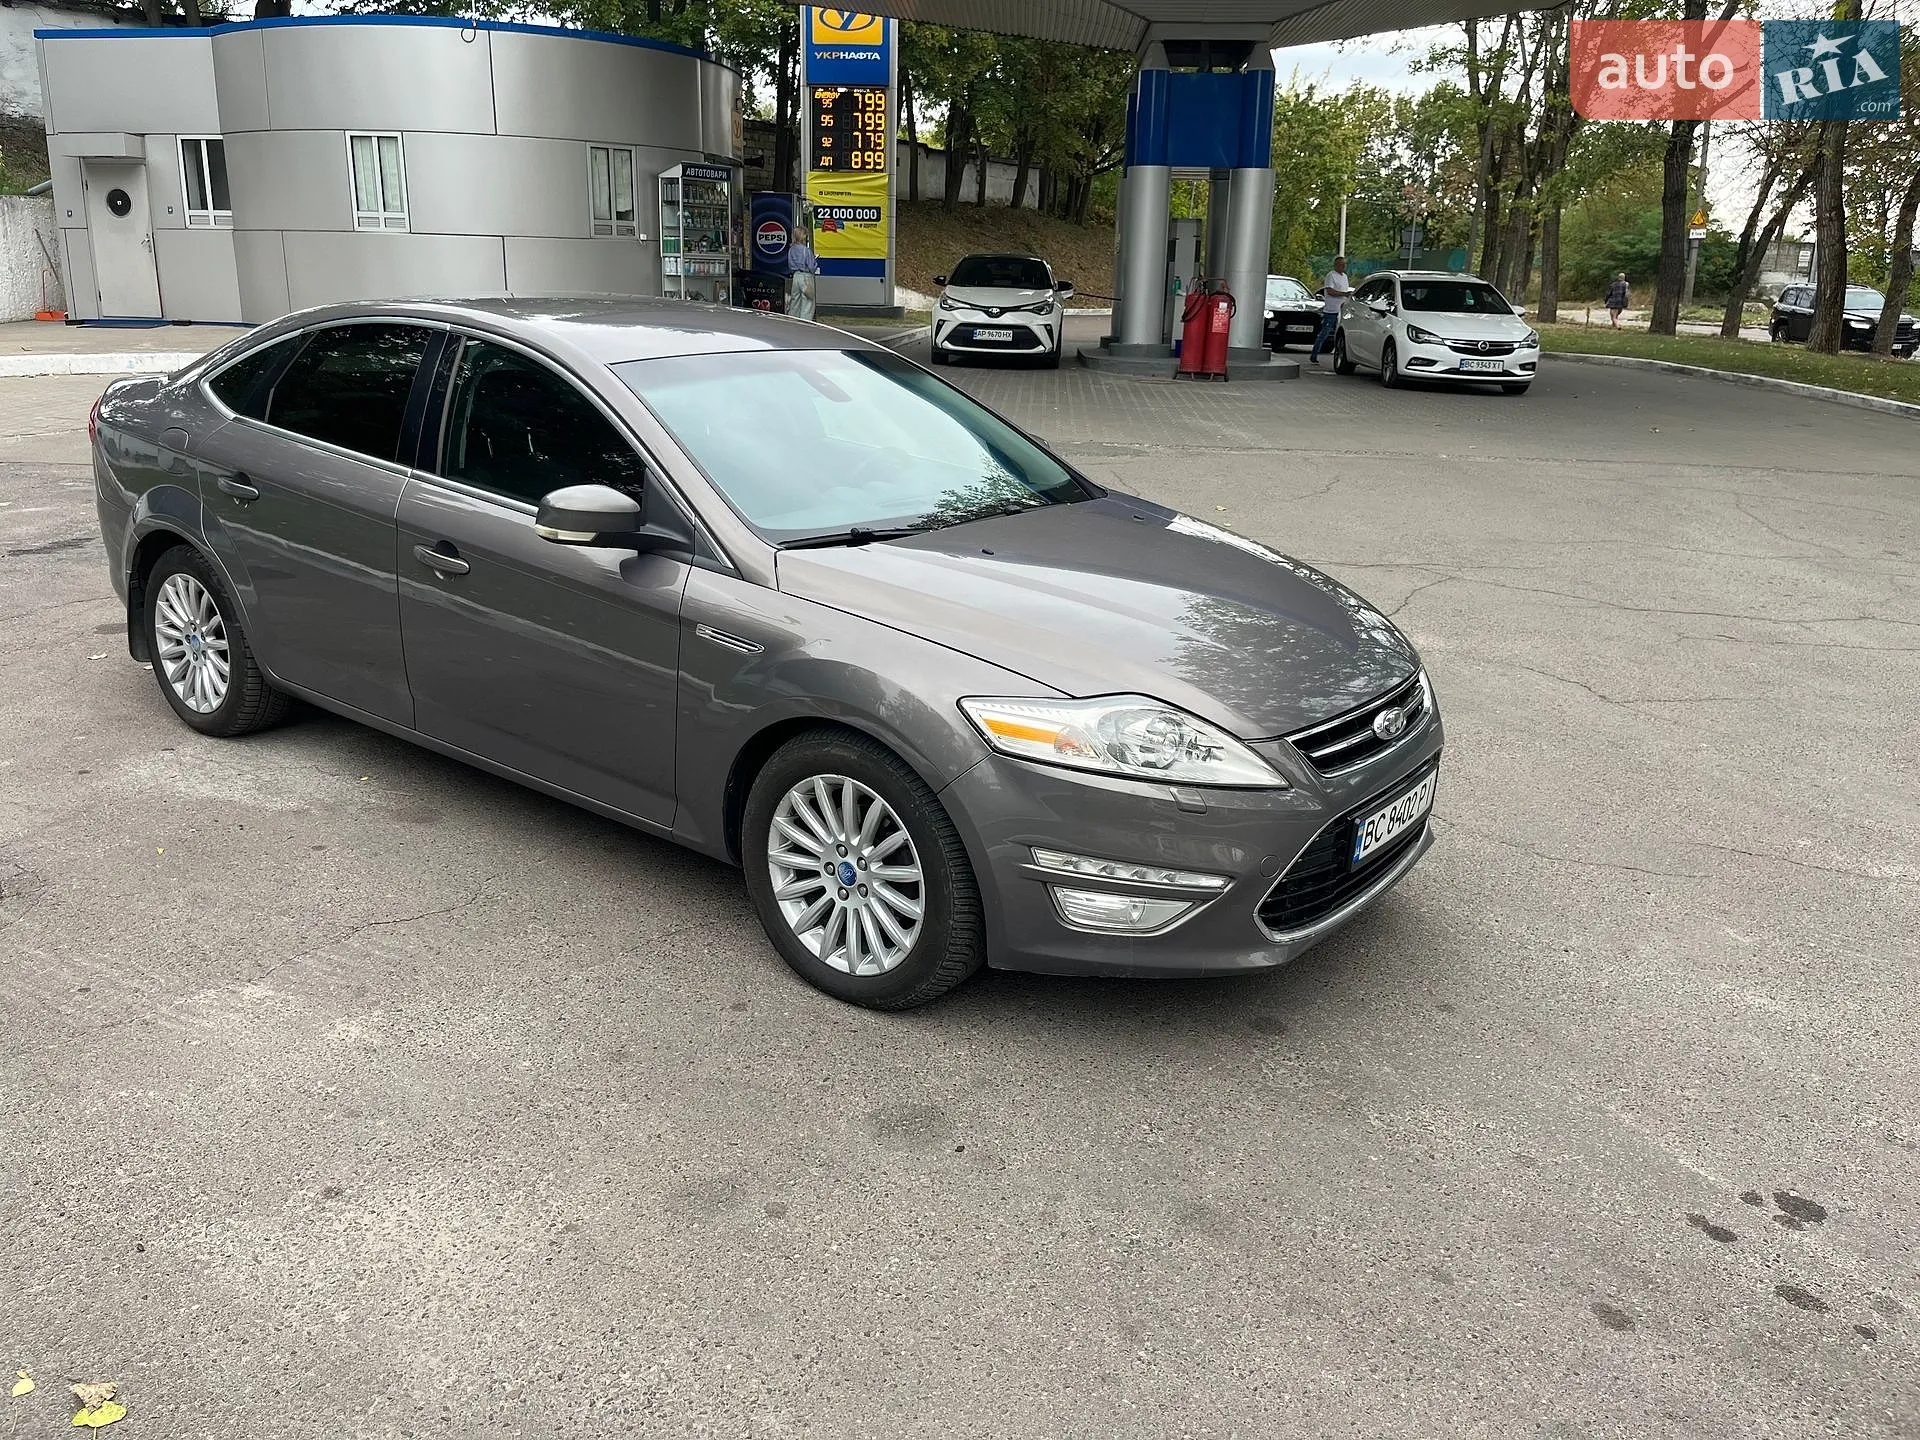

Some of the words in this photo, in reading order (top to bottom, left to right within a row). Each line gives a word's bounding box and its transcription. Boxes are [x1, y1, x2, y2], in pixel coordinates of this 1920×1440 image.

[814, 51, 881, 60] УКРНАФТА
[822, 98, 833, 108] 95
[853, 93, 885, 111] 799
[820, 114, 834, 127] 95
[853, 112, 885, 130] 799
[821, 137, 833, 148] 92
[852, 132, 885, 150] 779
[851, 151, 885, 169] 899
[685, 167, 728, 179] АВТОТОВАРИ
[817, 208, 831, 219] 22
[832, 208, 854, 219] 000
[856, 209, 878, 220] 000
[758, 234, 786, 242] PEPSI
[1363, 812, 1386, 852] BC
[1387, 790, 1417, 835] 8402
